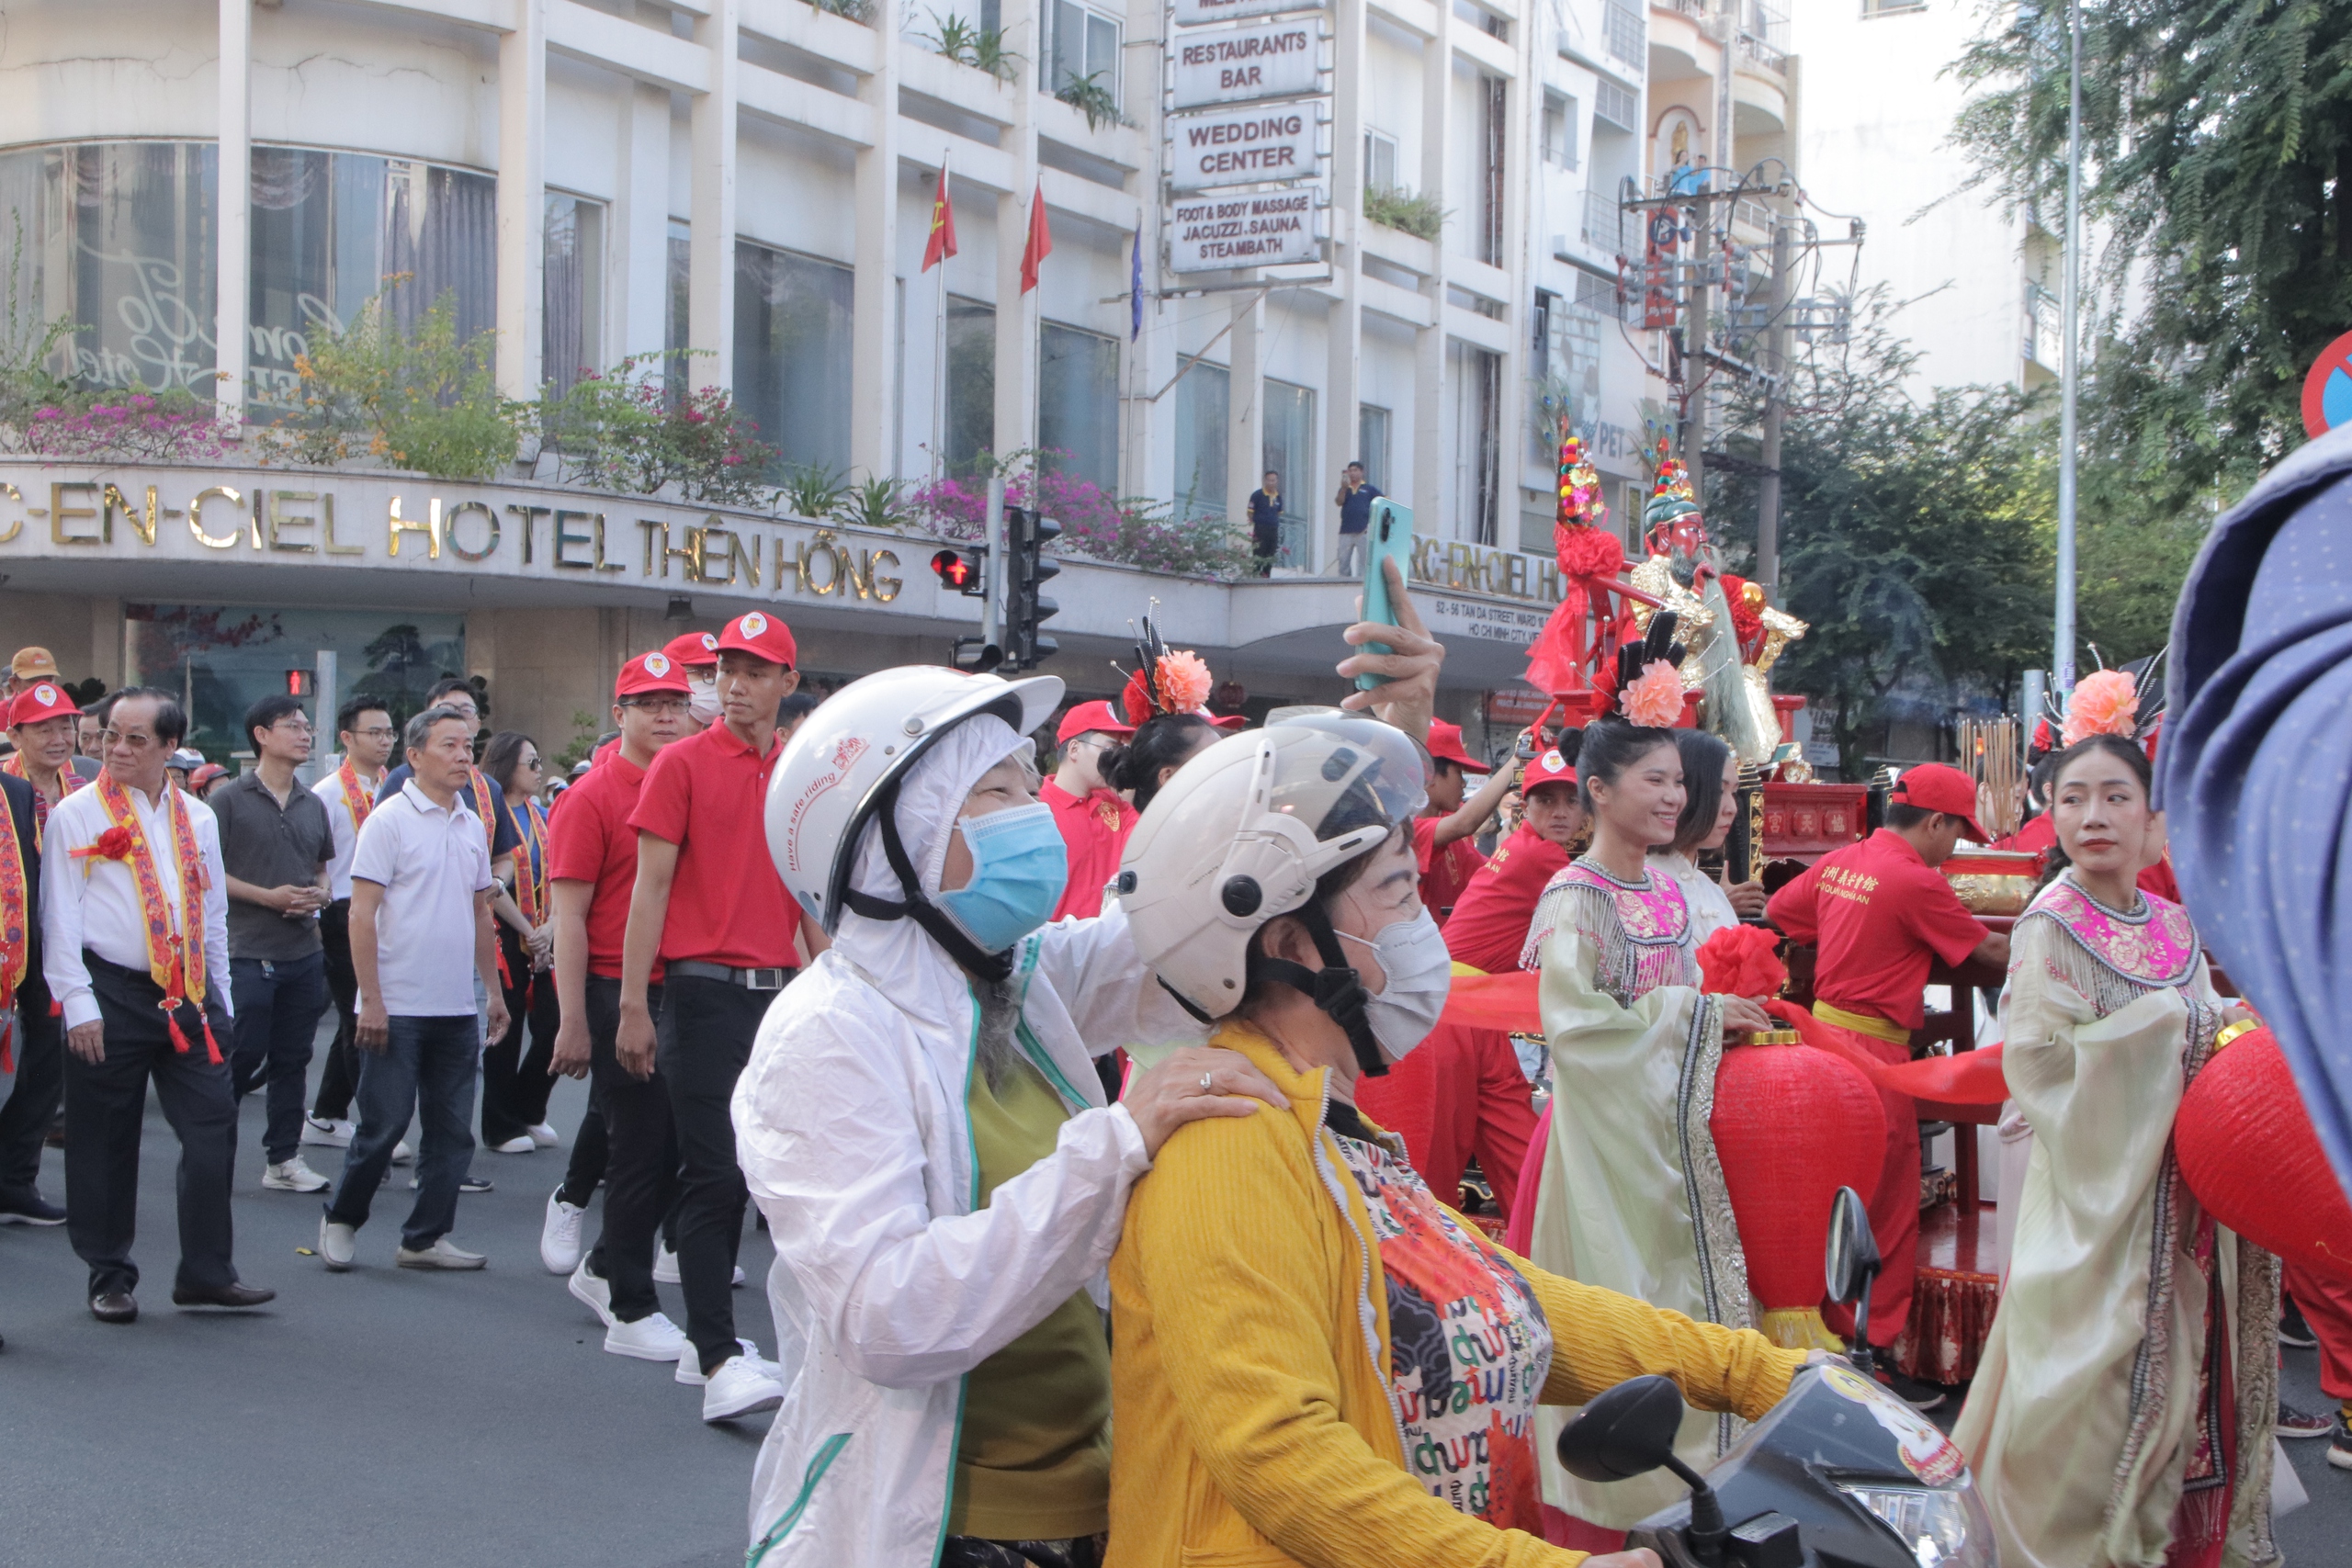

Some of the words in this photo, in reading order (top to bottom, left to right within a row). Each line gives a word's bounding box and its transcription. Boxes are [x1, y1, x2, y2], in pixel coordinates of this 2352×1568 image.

[1182, 31, 1306, 65] RESTAURANTS
[1221, 67, 1261, 88] BAR
[1189, 116, 1302, 147] WEDDING
[1200, 146, 1295, 174] CENTER
[1217, 201, 1249, 219] BODY
[1252, 196, 1308, 215] MASSAGE
[1200, 238, 1283, 259] STEAMBATH
[389, 495, 627, 571] HOTEL
[1436, 601, 1444, 614] 52
[1462, 604, 1476, 618] TAN
[1476, 607, 1487, 620] DA
[1517, 614, 1536, 626] WARD
[1469, 623, 1479, 636] HO
[1482, 625, 1492, 637] CHI
[1493, 626, 1510, 640] MINH
[805, 772, 836, 798] riding
[790, 798, 805, 825] safe
[787, 840, 797, 871] Have
[1856, 895, 1870, 905] AN
